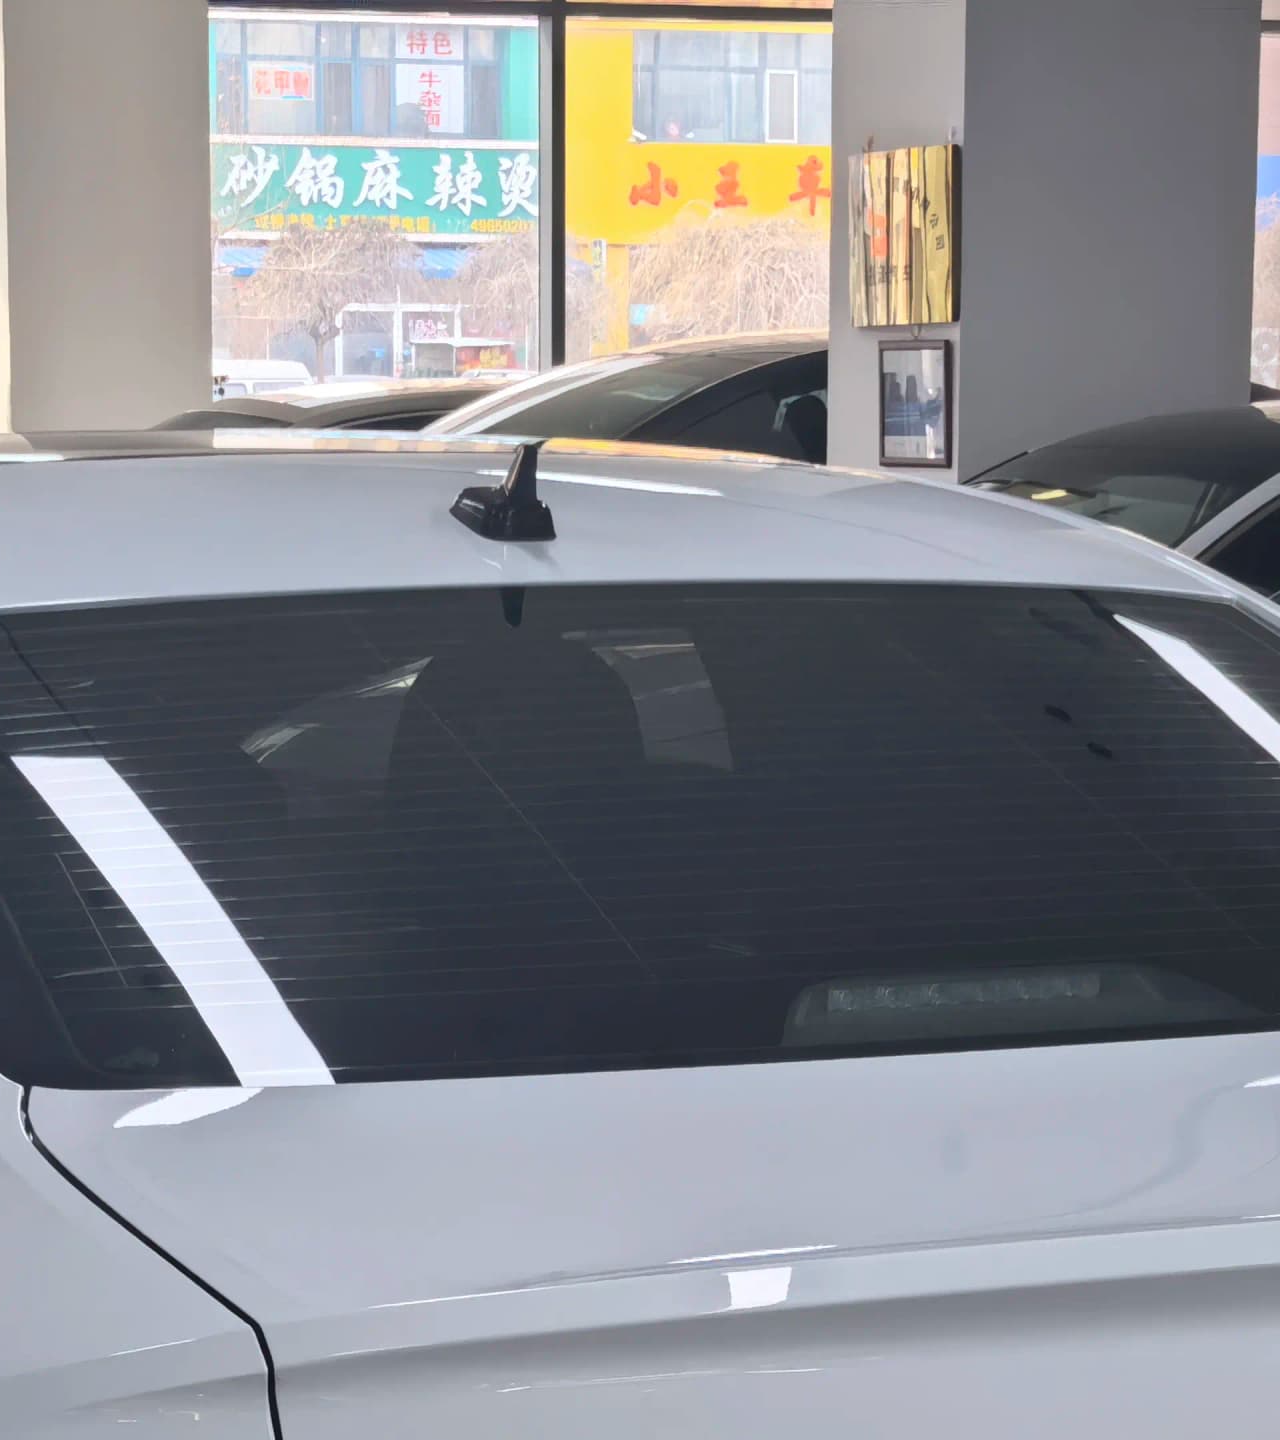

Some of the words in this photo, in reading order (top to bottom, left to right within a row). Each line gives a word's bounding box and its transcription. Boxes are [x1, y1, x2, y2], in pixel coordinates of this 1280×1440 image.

[406, 31, 453, 56] 特色
[219, 146, 538, 217] 砂锅麻辣烫
